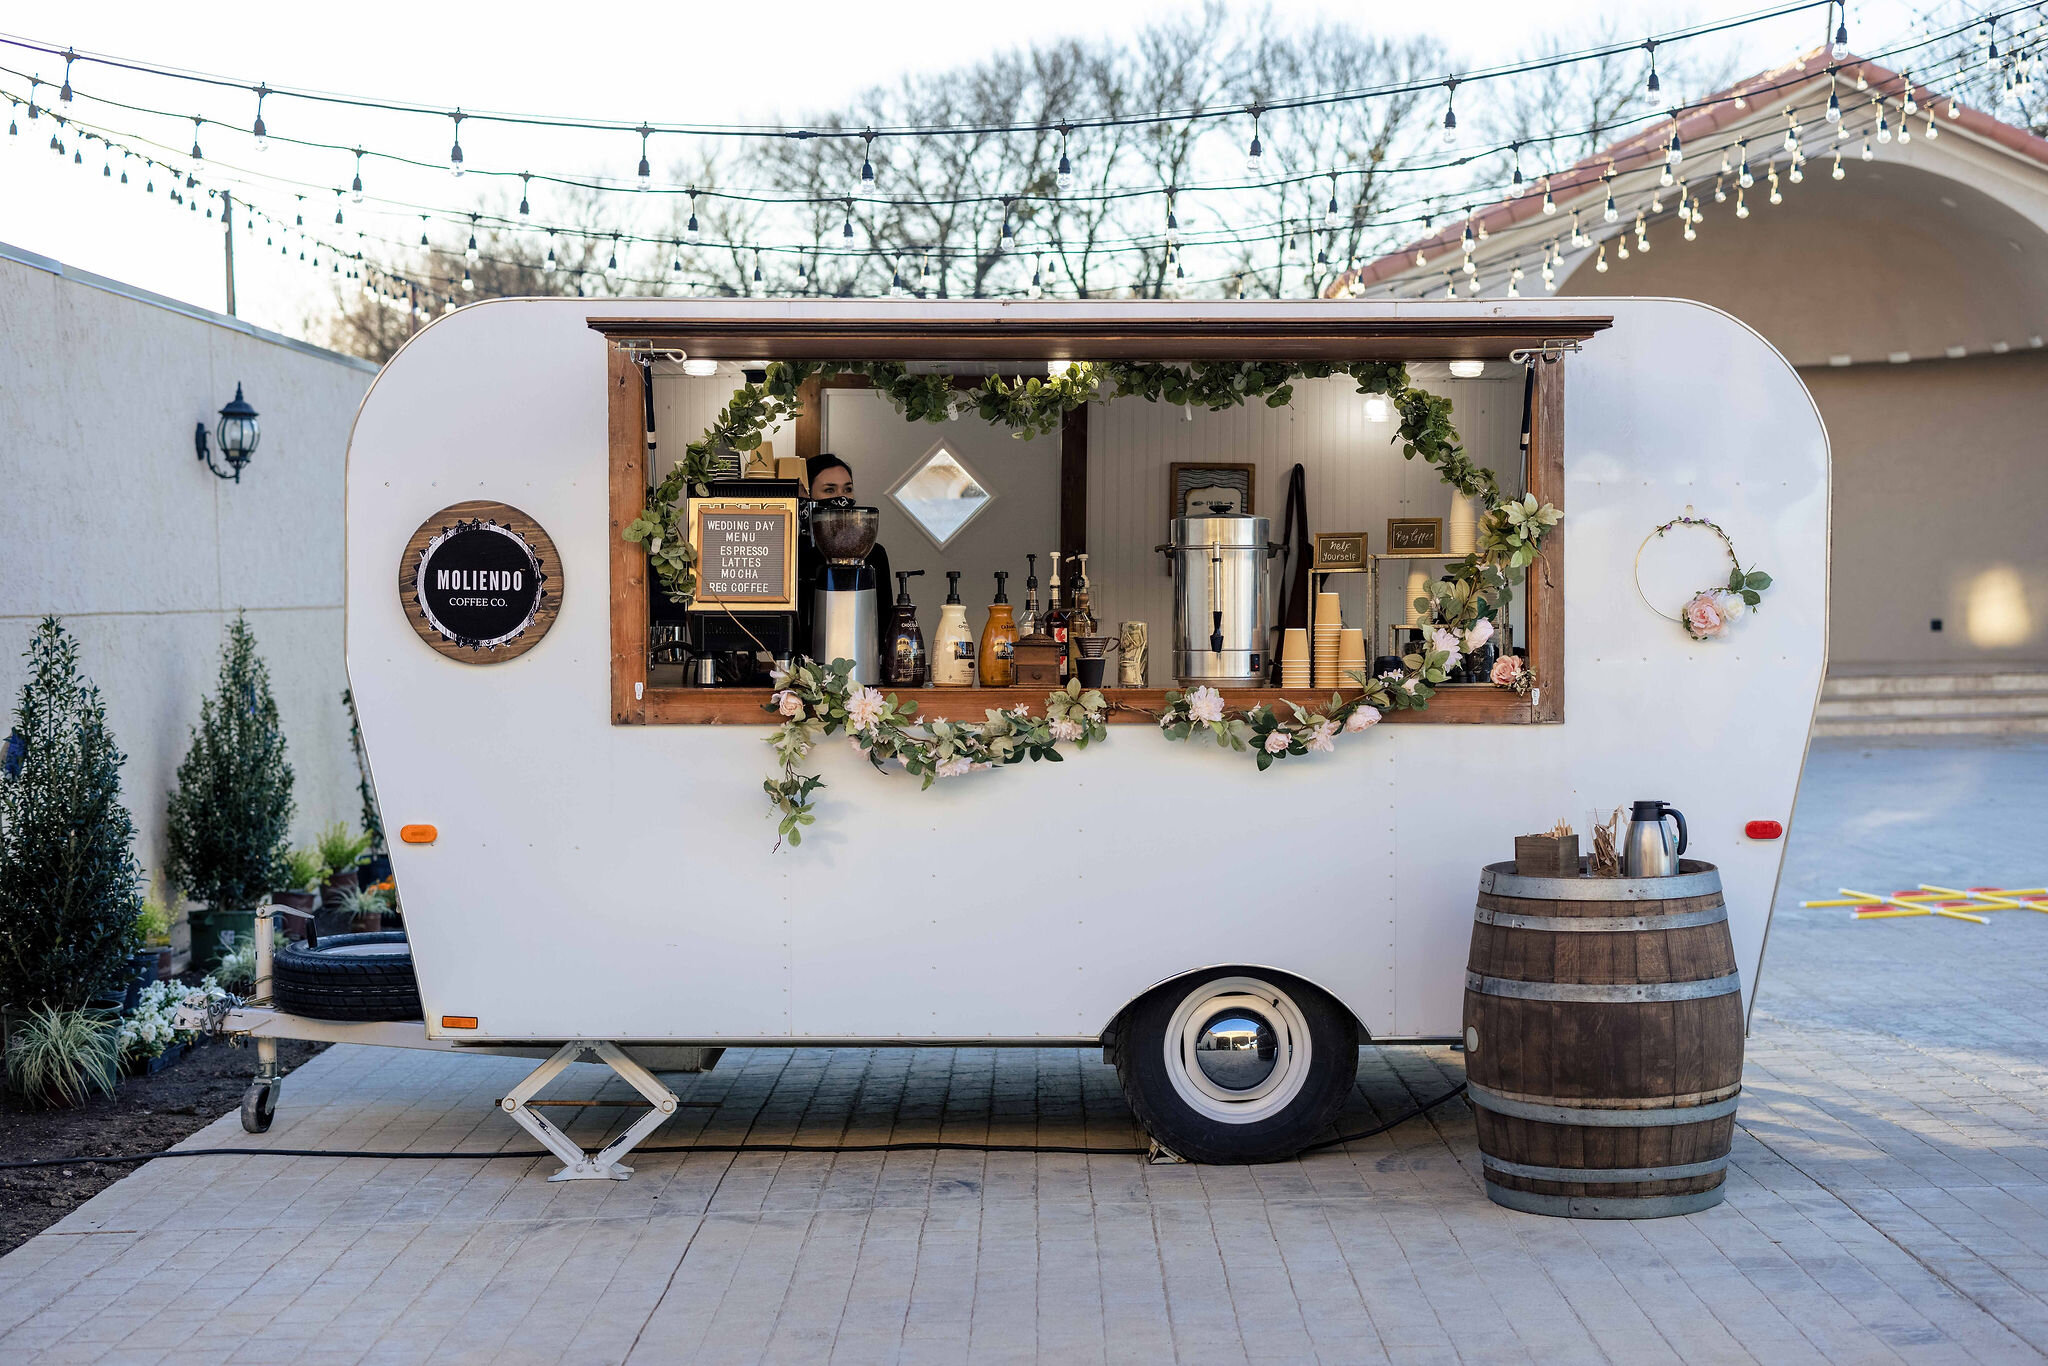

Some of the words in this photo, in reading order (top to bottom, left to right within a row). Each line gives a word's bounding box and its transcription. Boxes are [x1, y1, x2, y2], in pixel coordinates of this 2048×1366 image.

[707, 520, 749, 530] WEDDING
[755, 521, 775, 531] DAY
[725, 532, 755, 542] MENU
[720, 546, 769, 556] ESPRESSO
[722, 557, 761, 567] LATTES
[721, 568, 758, 578] MOCHA
[437, 569, 522, 591] MOLIENDO
[709, 582, 727, 592] REG
[731, 583, 768, 593] COFFEE
[449, 597, 489, 607] COFFEE
[490, 598, 508, 607] CO.
